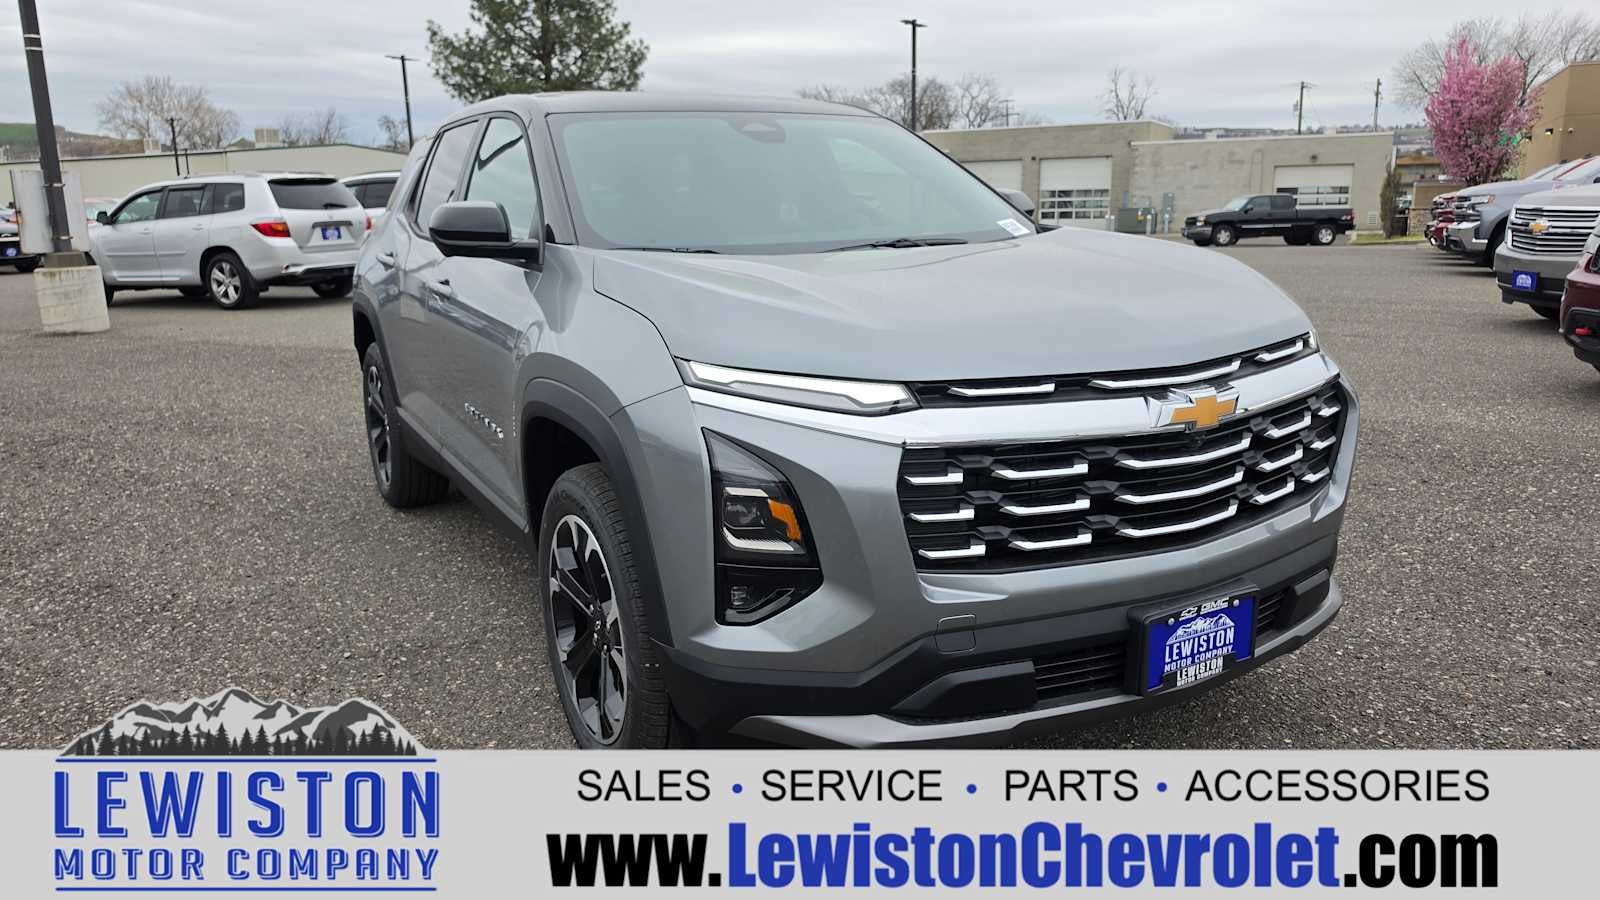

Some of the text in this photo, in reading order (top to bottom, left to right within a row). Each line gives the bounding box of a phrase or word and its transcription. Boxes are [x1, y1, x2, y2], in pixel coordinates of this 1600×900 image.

[1200, 597, 1229, 611] GMC
[1165, 627, 1234, 663] LEWISTON
[1164, 644, 1233, 673] MOTOR COMPANY
[1176, 657, 1223, 680] LEWISTON
